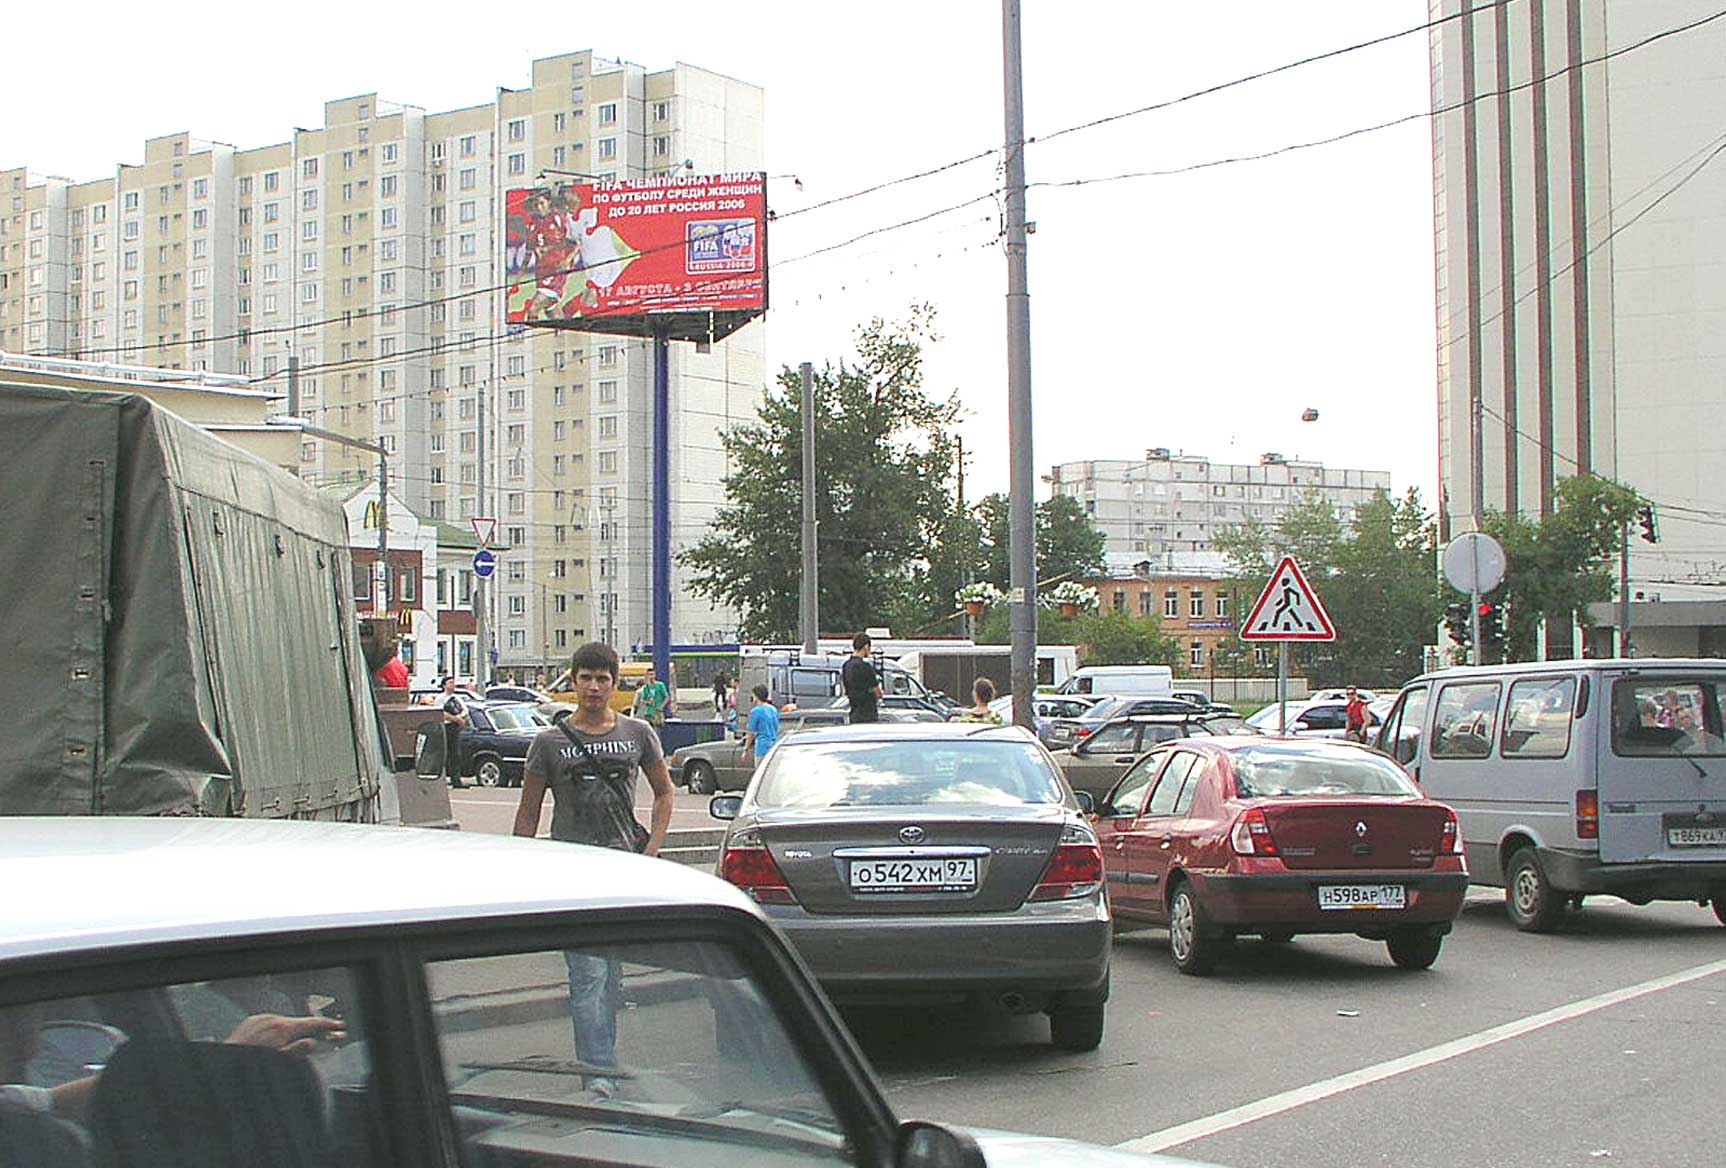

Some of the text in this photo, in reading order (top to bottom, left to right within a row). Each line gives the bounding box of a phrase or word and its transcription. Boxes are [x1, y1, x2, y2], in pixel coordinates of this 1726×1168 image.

[593, 172, 761, 192] FIFA ЧЕМПИОНАТ МИРА
[592, 184, 763, 204] ПО ФУТБОЛУ СРЕДИ ЖЕНЩИН
[608, 199, 745, 219] ДО 20 ЛЕТ РОССИЯ 2006
[694, 240, 718, 252] FIFA
